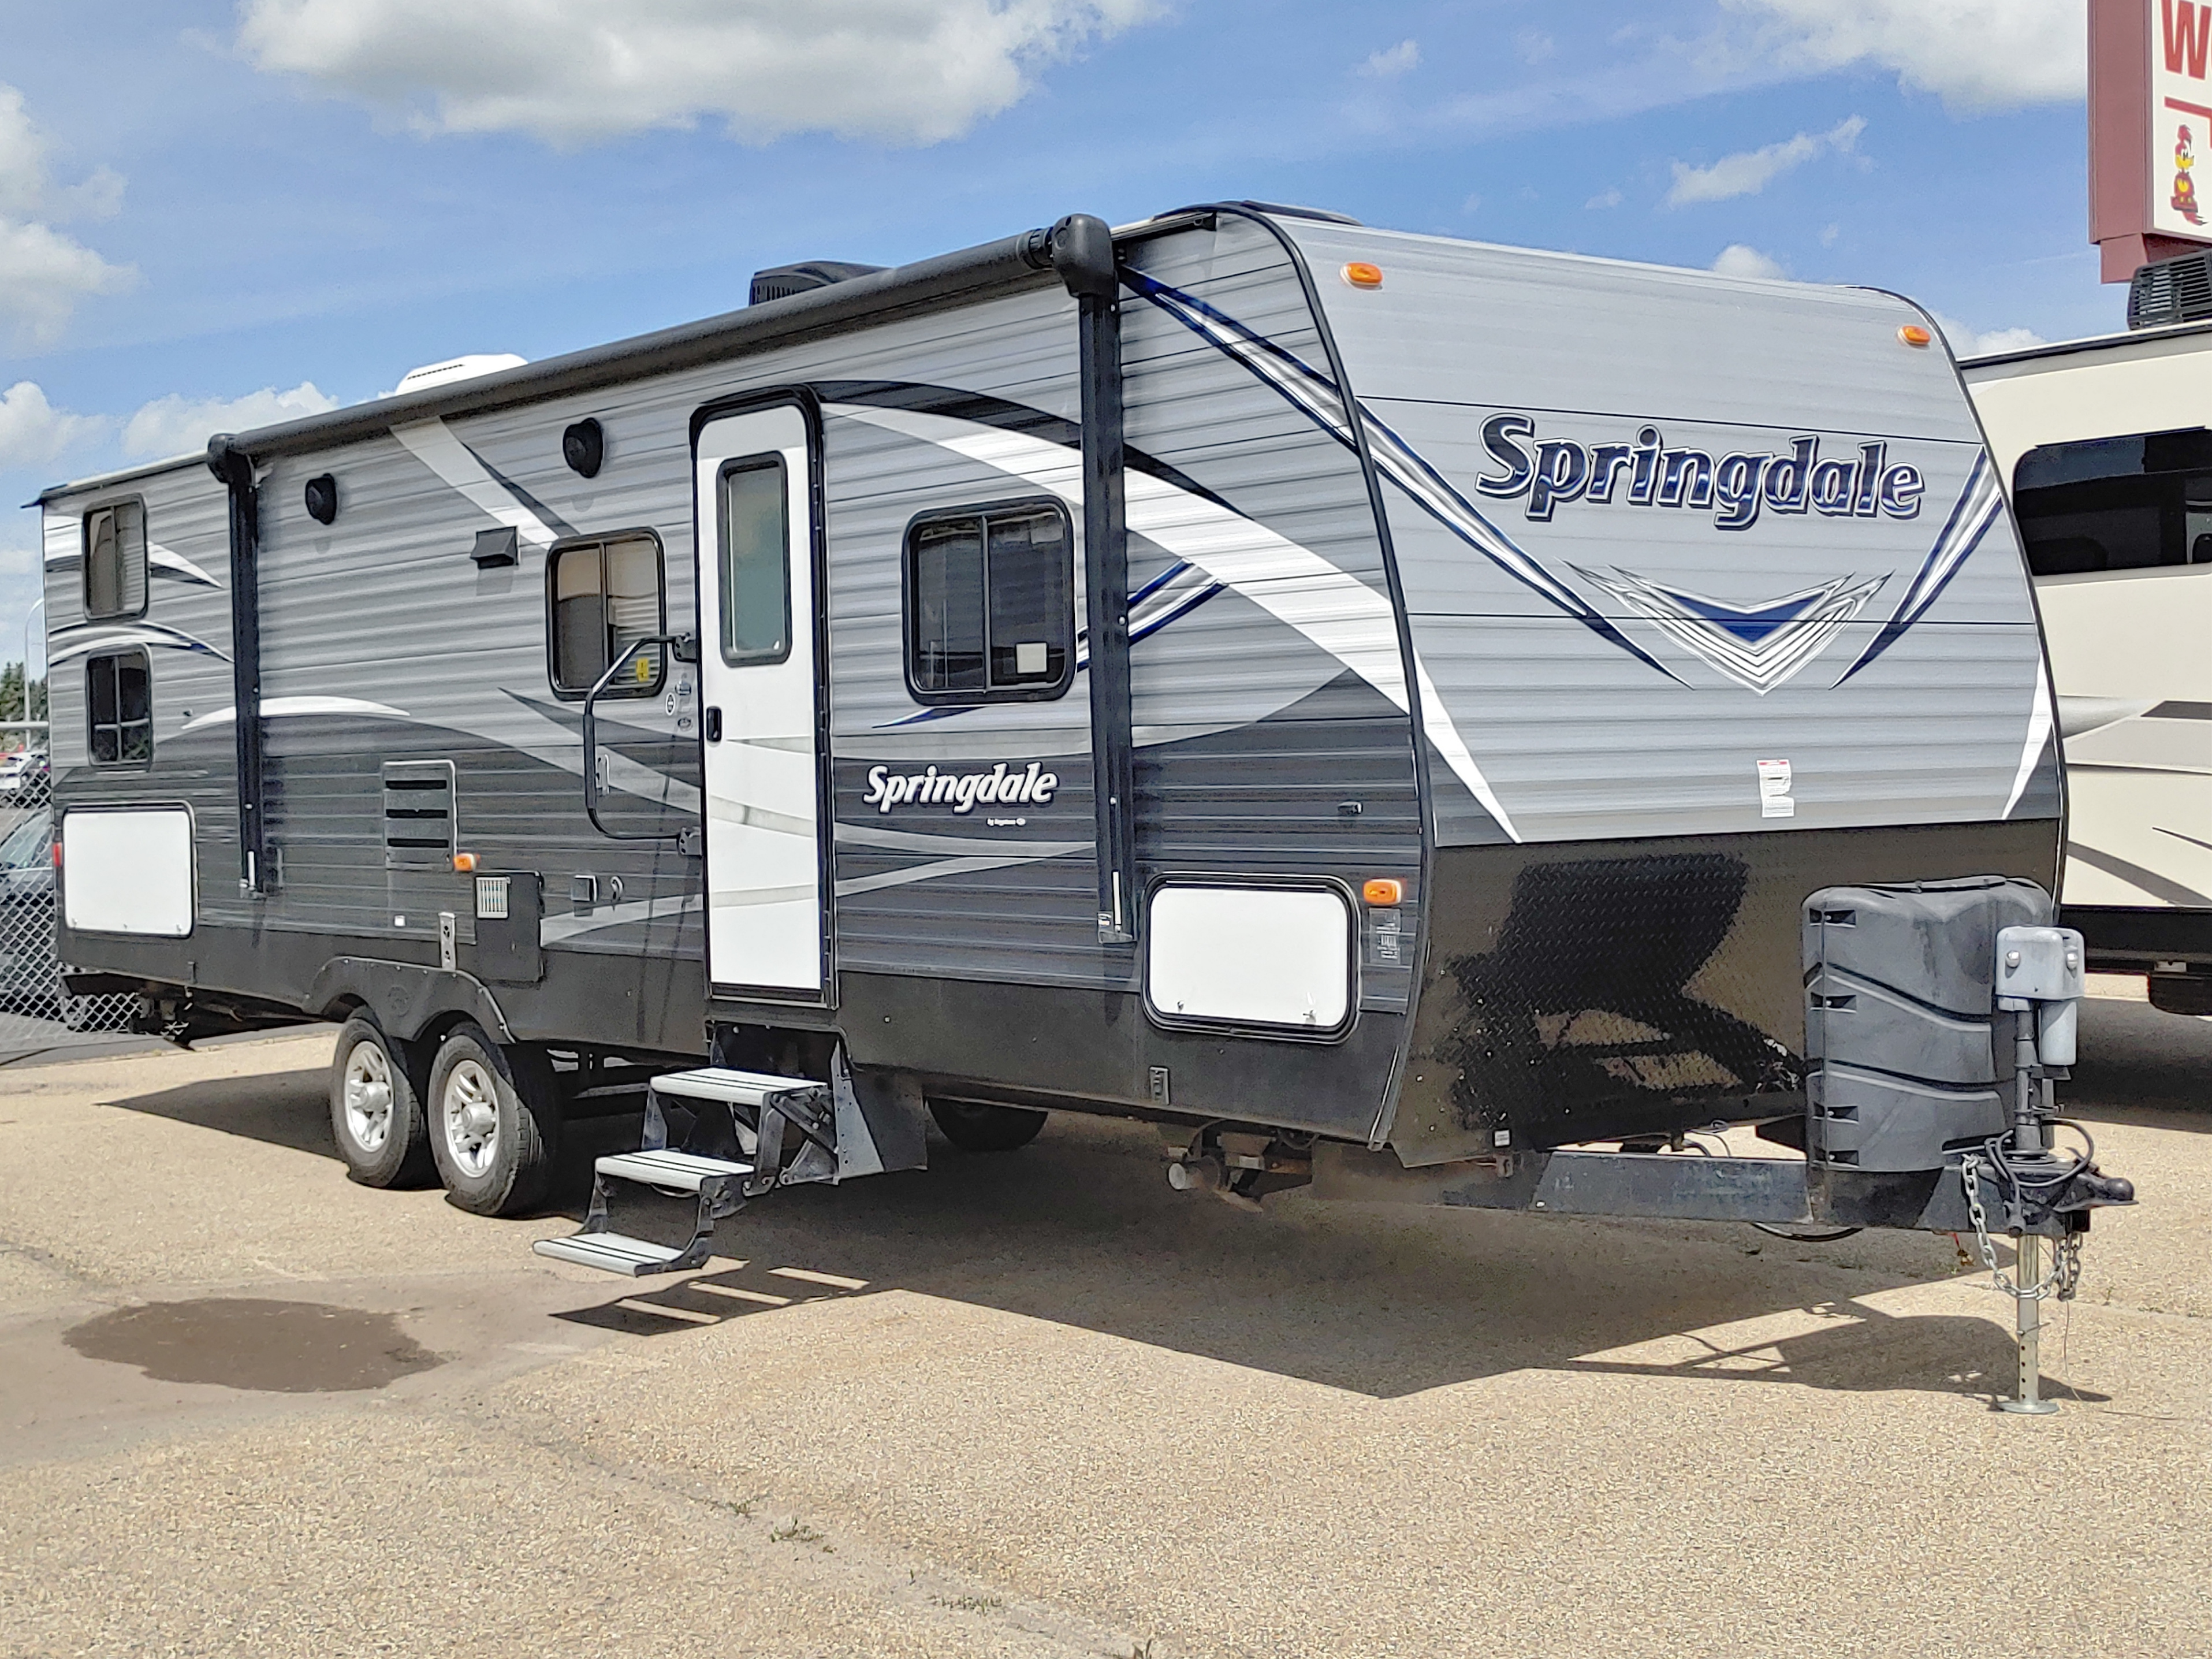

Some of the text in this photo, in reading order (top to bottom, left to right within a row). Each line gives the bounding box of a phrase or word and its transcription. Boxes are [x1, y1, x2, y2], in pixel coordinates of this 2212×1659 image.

[2161, 0, 2212, 80] W
[1475, 412, 1926, 530] Springdale
[863, 762, 1058, 813] Springdale
